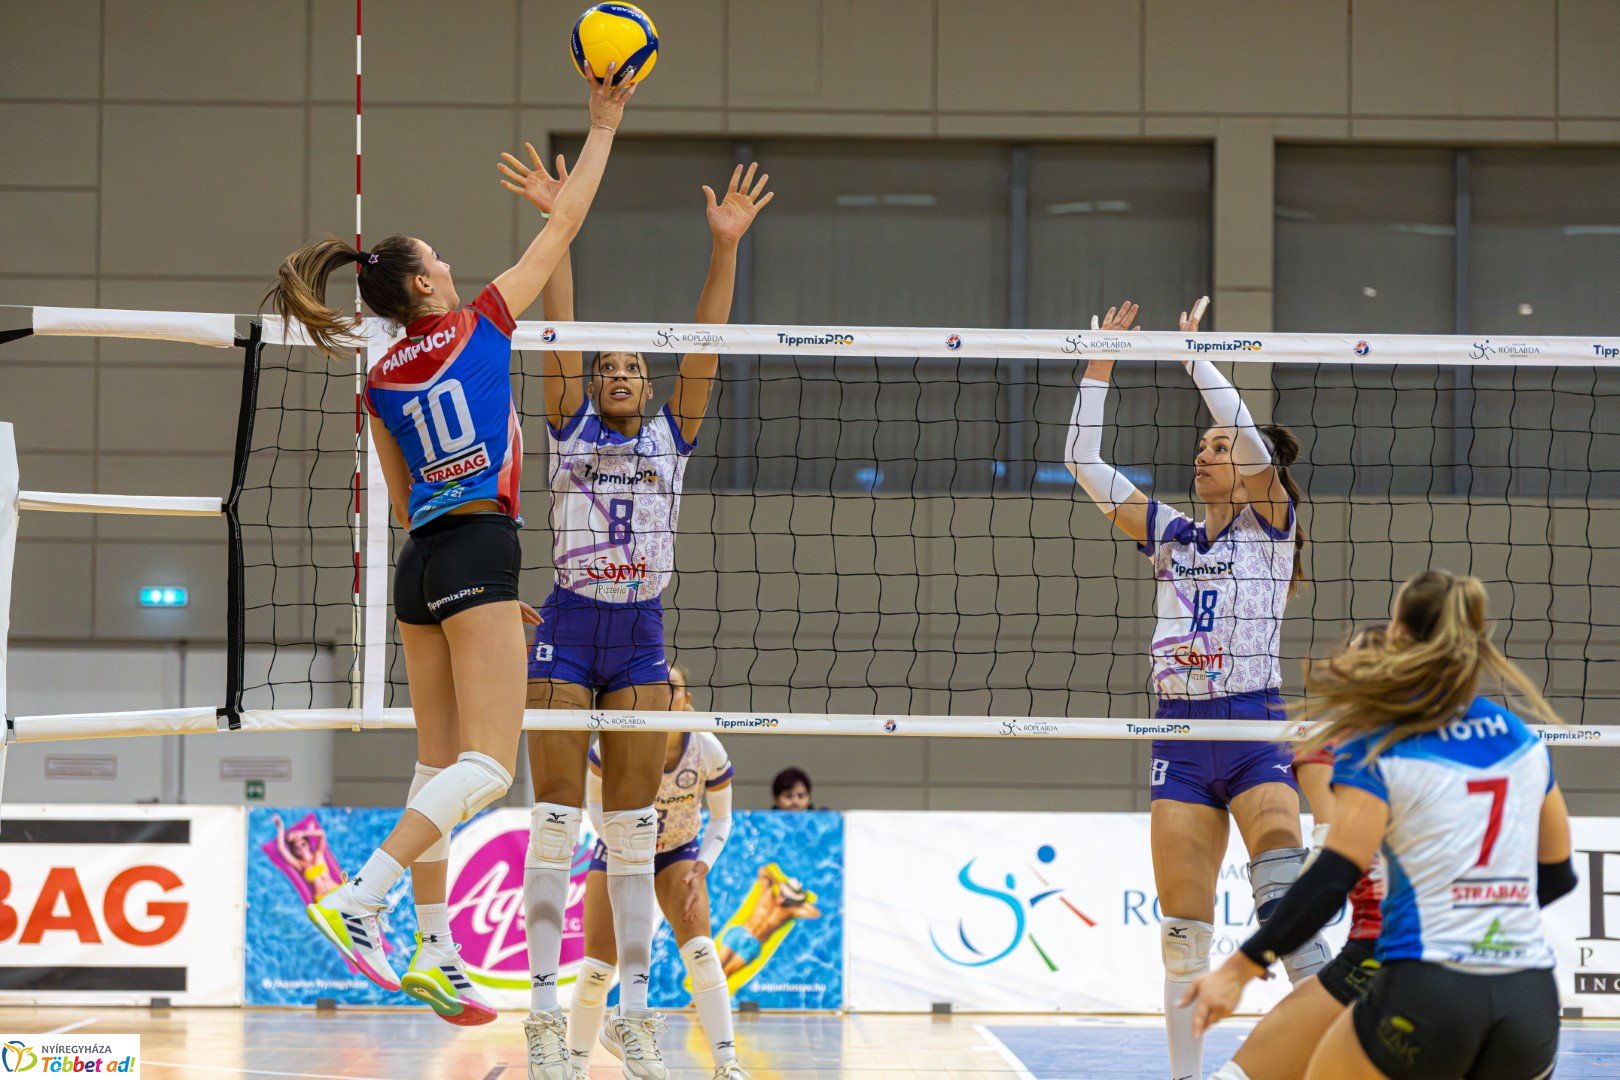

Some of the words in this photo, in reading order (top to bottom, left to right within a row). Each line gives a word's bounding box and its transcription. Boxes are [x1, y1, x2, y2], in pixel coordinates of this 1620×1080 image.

[382, 326, 456, 375] PAMPUCH
[777, 333, 854, 346] TippmixPRO
[1185, 339, 1262, 352] TippmixPRO
[402, 378, 476, 464] 10
[426, 454, 487, 483] STRABAG
[608, 499, 634, 545] 8
[586, 556, 646, 584] Capri
[1189, 590, 1218, 632] 18
[1174, 646, 1223, 670] Capri
[714, 717, 779, 729] TippmixPRO
[1126, 723, 1191, 735] TippmixPRO
[1537, 730, 1601, 741] TippmixPRO
[1150, 758, 1169, 786] 8
[1466, 776, 1509, 867] 7
[0, 865, 189, 947] AG
[1452, 885, 1529, 900] STRABAG
